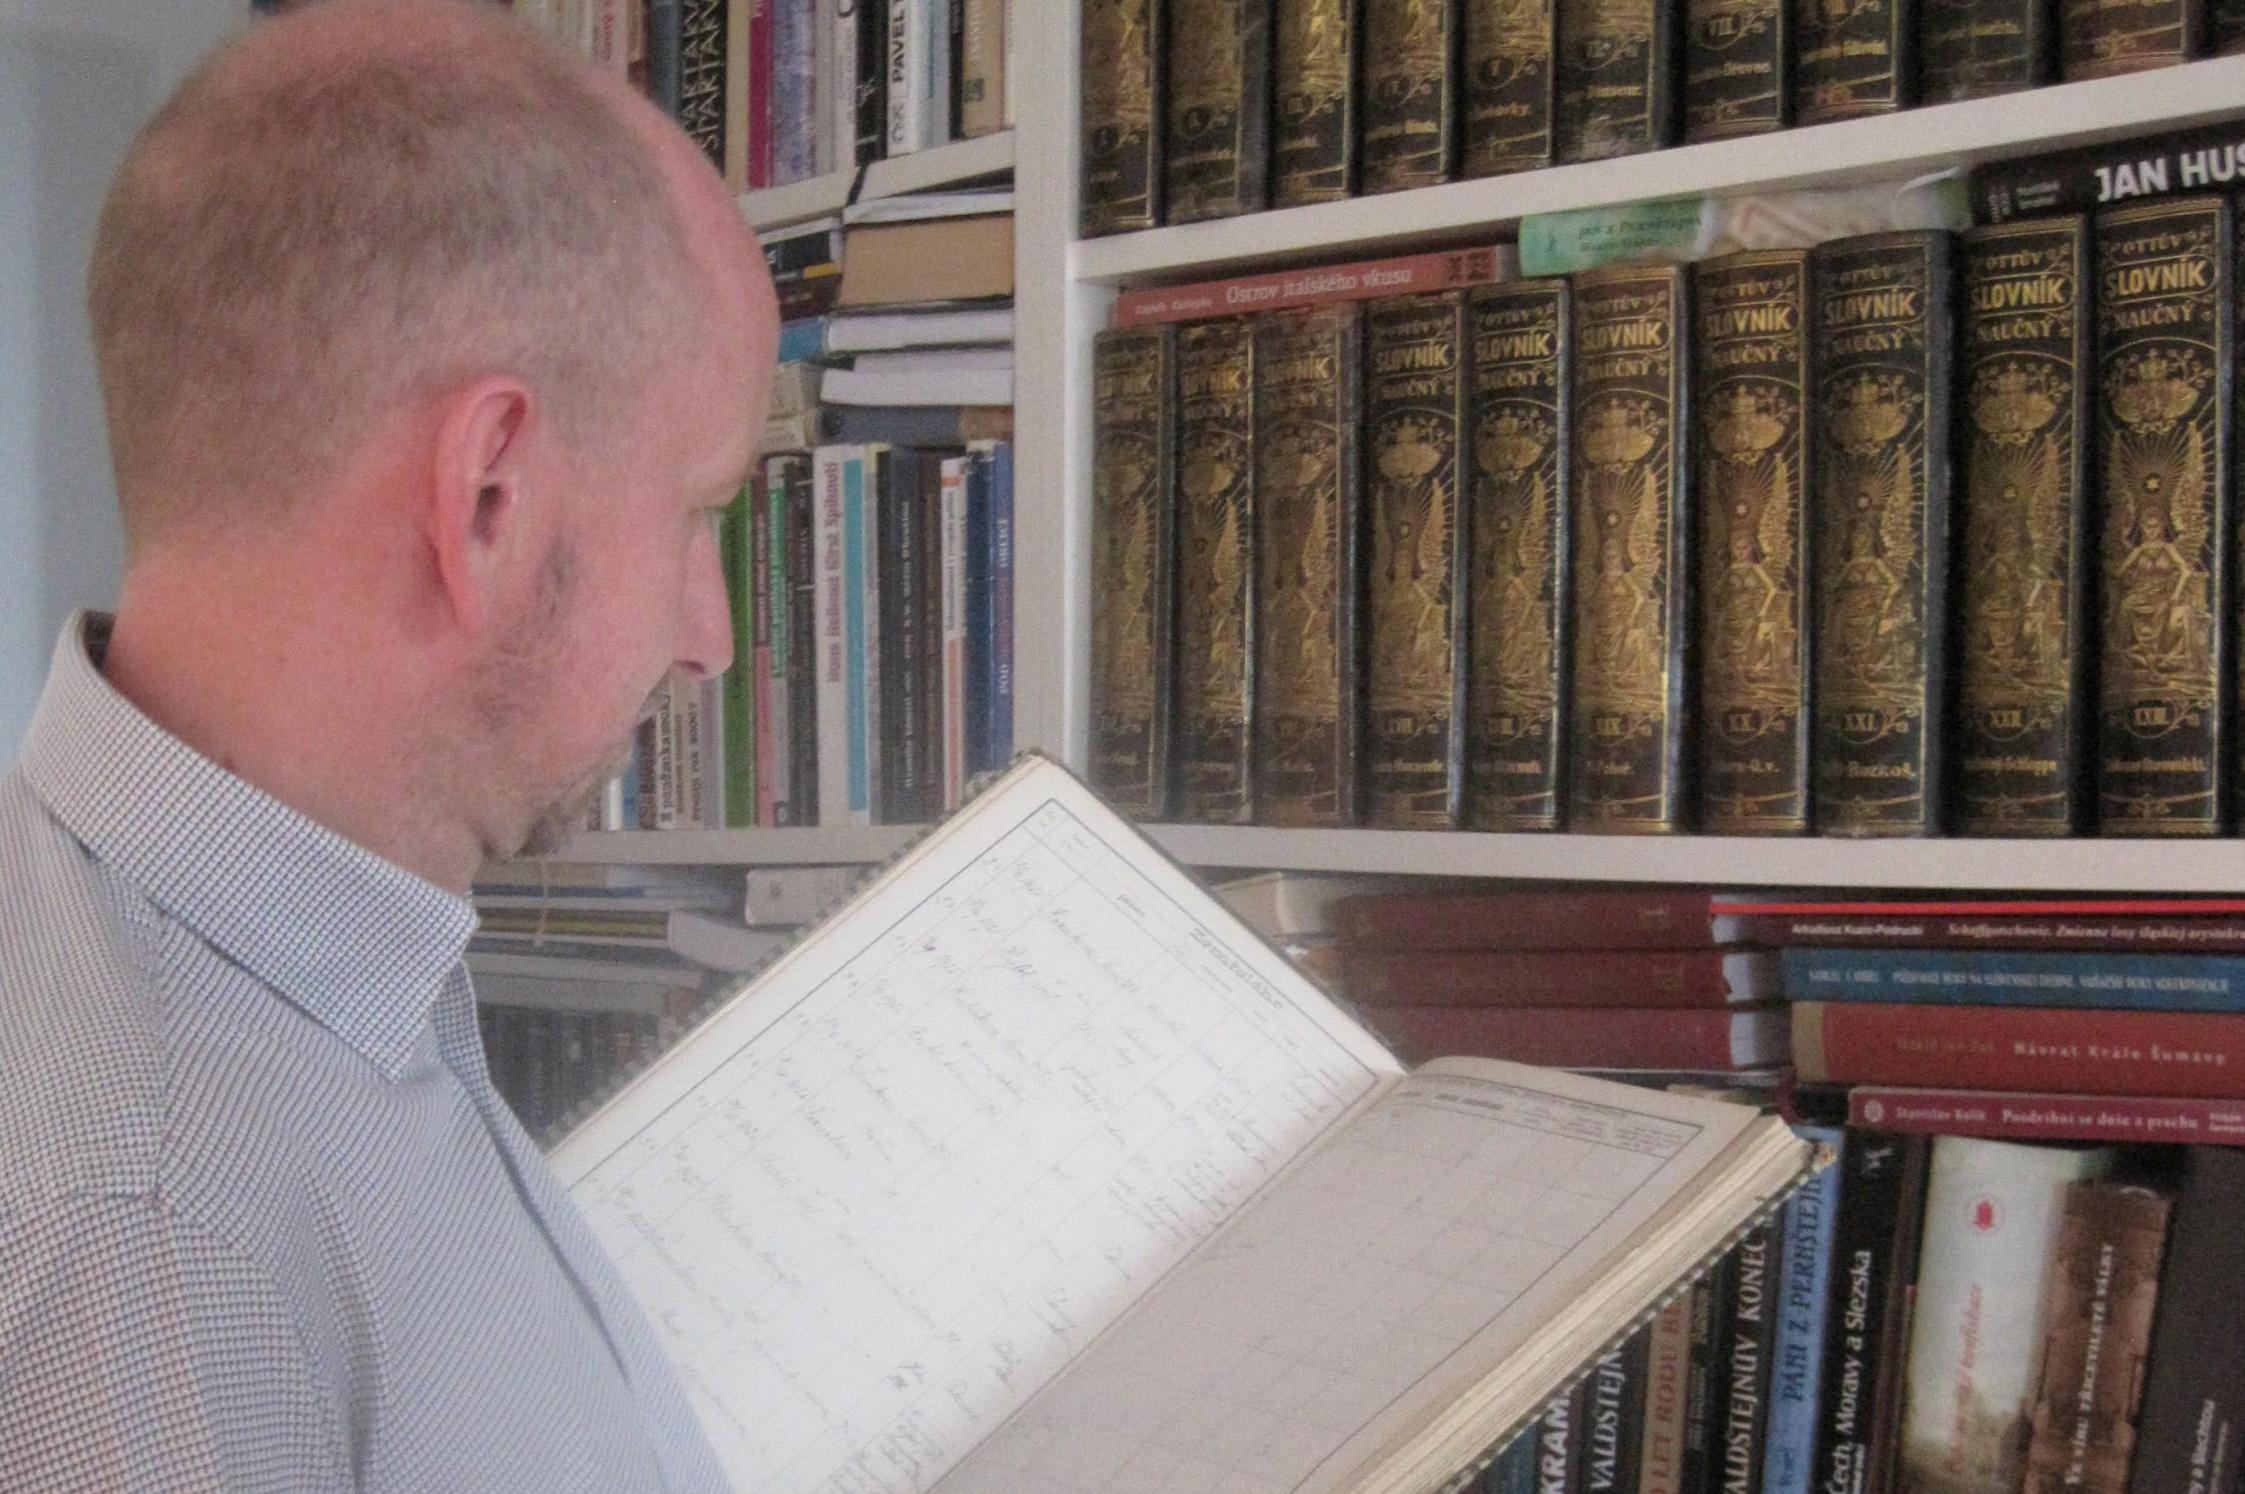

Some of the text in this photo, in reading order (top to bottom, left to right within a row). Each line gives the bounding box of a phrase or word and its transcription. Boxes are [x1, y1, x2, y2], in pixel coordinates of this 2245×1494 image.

[891, 9, 905, 83] PAVEL
[2094, 157, 2169, 202] JAN
[1226, 280, 1279, 304] Ostrov
[1971, 274, 2066, 313] SLOVNÍK
[2106, 257, 2208, 298] SLOVNÍK
[1825, 287, 1917, 324] SLOVNÍK
[2013, 1041, 2079, 1059] Návrat
[2149, 1042, 2227, 1067] Šumavy
[2147, 1114, 2199, 1131] prachu
[1845, 1249, 1873, 1330] Slezska
[1790, 1318, 1810, 1333] Z
[1849, 1336, 1863, 1351] a
[1723, 1238, 1767, 1494] ALDŠTEJNŮV KONEC
[1780, 1344, 1806, 1404] PÁNI
[1837, 1354, 1863, 1435] Moravy
[1541, 1387, 1571, 1494] KRAM
